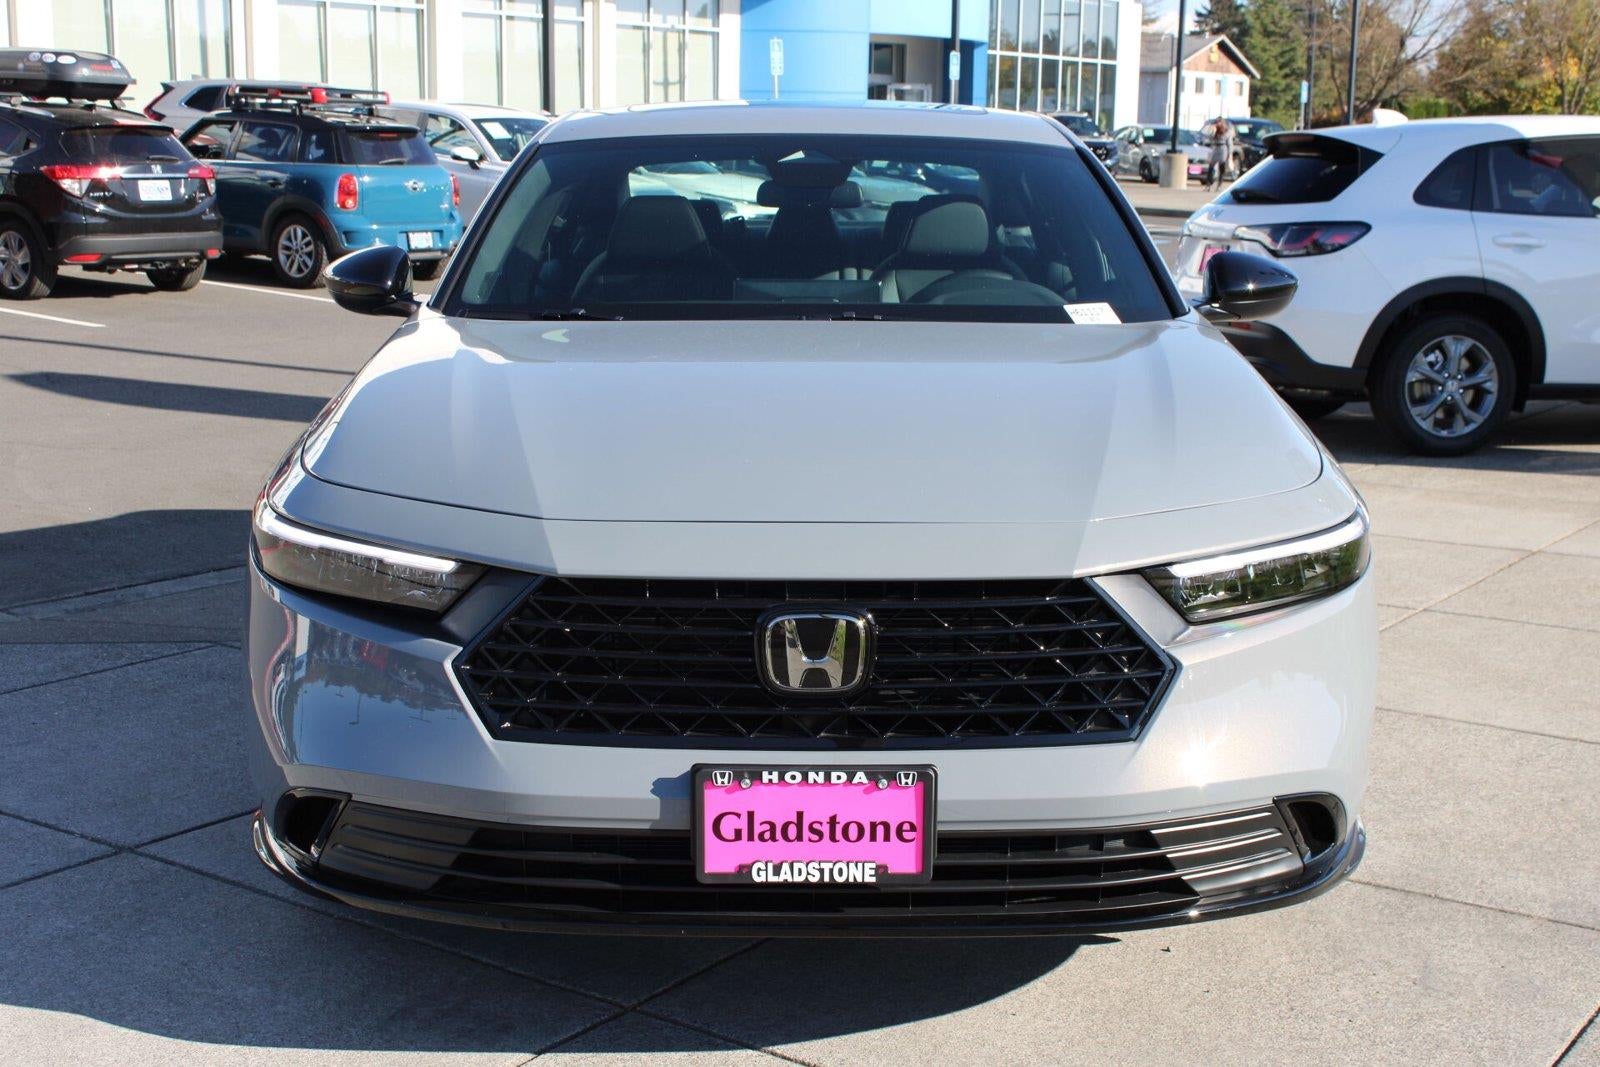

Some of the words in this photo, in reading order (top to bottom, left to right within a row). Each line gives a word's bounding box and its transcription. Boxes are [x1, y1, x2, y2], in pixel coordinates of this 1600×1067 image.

[761, 771, 869, 784] HONDA
[711, 811, 918, 843] Gladstone
[751, 862, 877, 883] GLADSTONE
